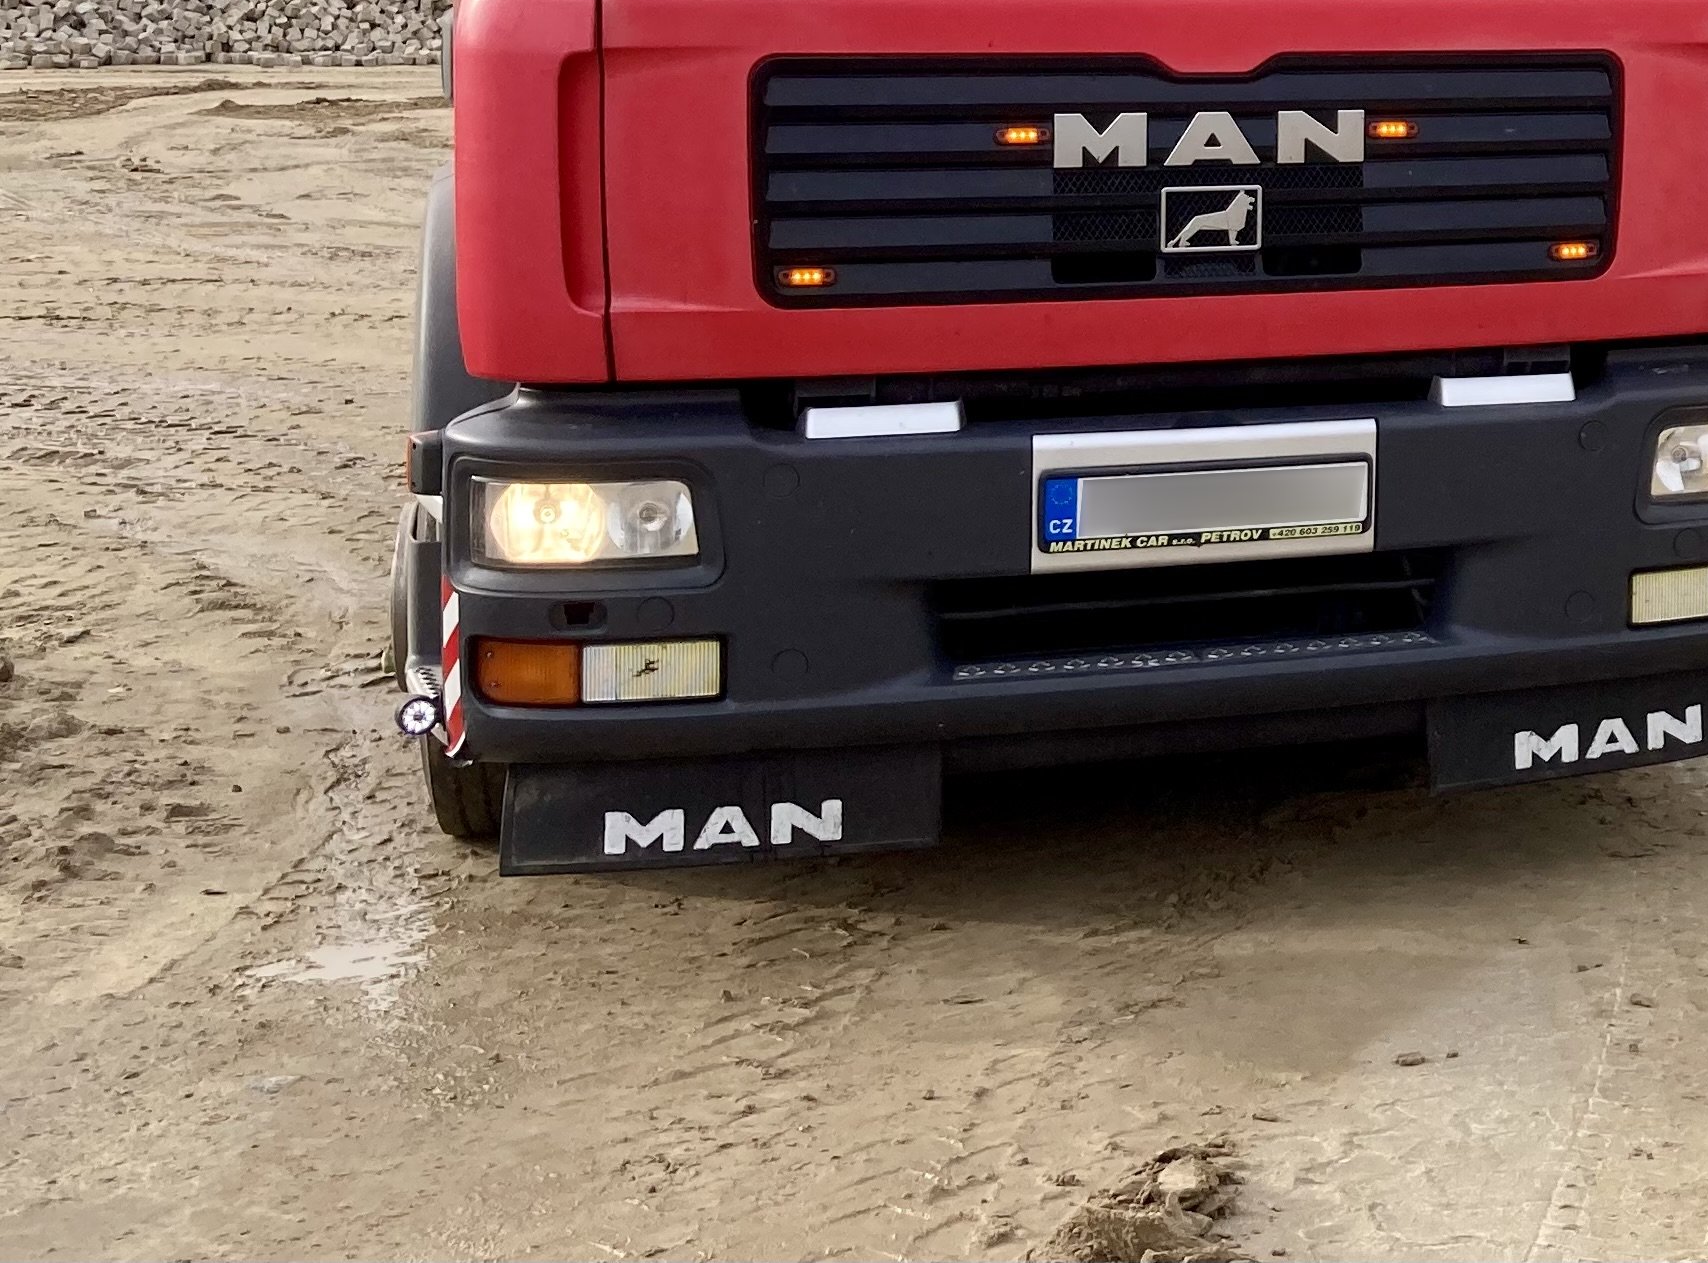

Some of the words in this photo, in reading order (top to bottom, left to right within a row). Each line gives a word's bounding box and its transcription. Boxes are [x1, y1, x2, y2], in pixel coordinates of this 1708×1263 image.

[1053, 109, 1365, 169] MAN
[1049, 518, 1073, 534] CZ
[1049, 537, 1132, 553] MARTINEK
[1136, 535, 1169, 548] CAR
[1200, 529, 1263, 543] PETROV
[1514, 703, 1703, 770] MAN
[603, 798, 843, 855] MAN
